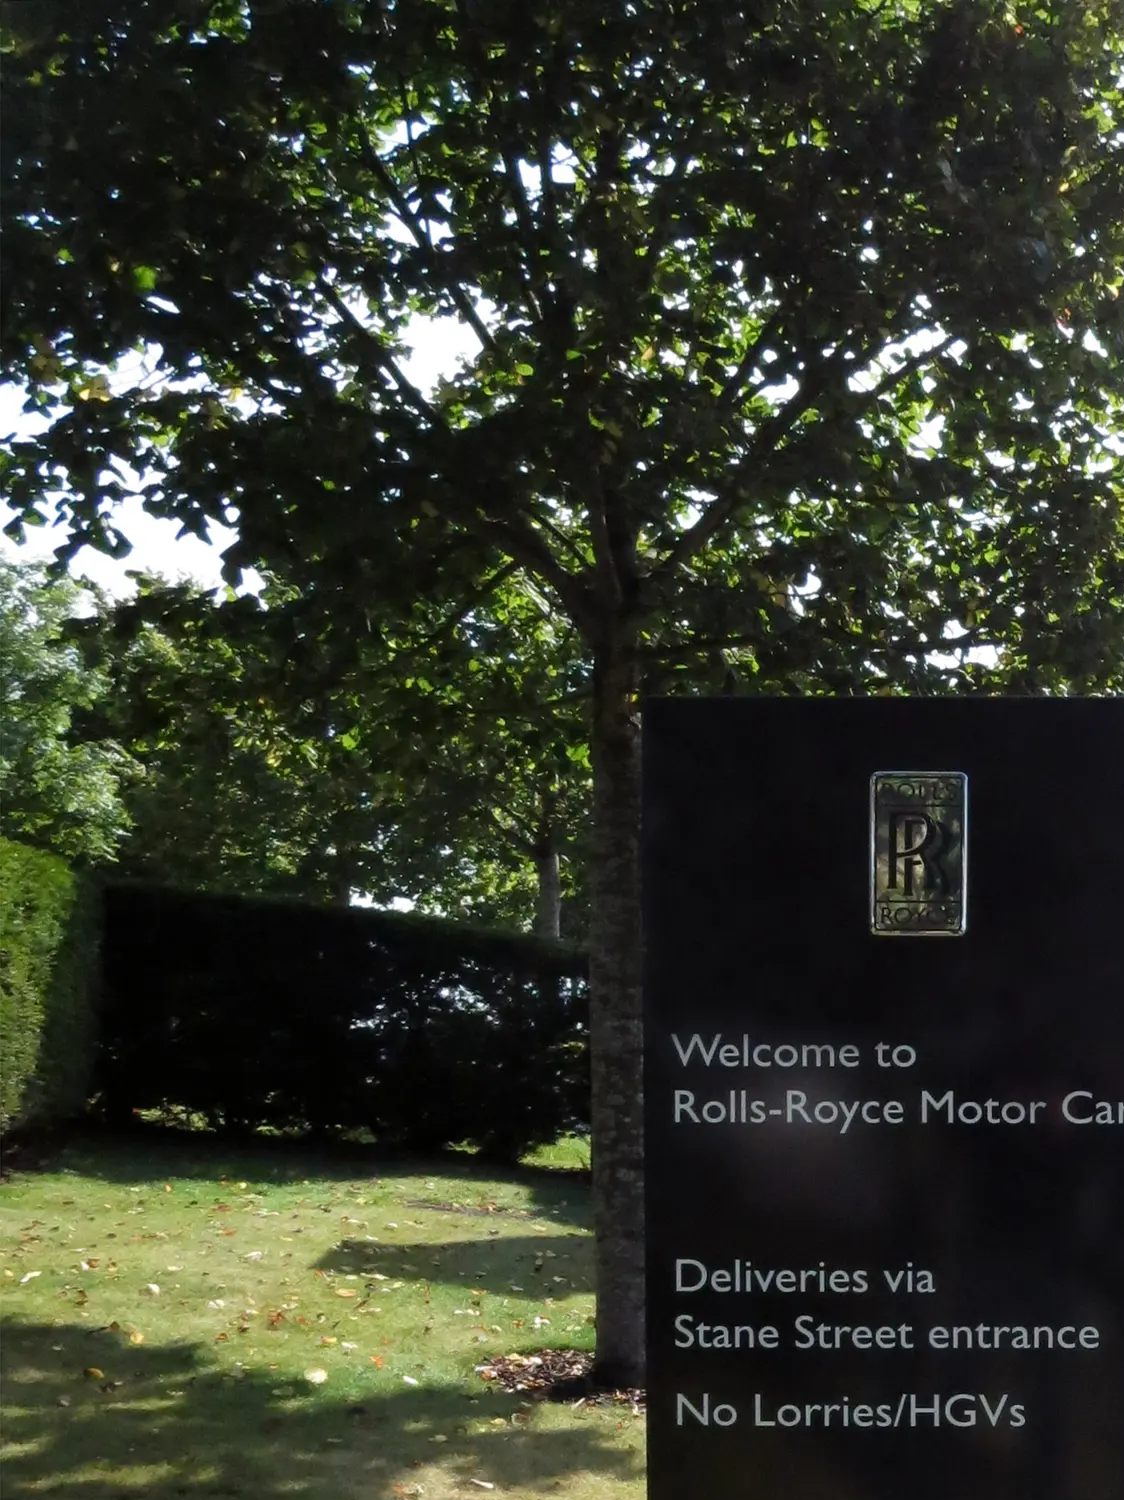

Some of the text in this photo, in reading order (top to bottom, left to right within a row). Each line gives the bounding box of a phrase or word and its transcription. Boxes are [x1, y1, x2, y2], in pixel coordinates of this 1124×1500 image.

[672, 1033, 917, 1068] Welcome to
[674, 1089, 904, 1134] Rolls-Royce
[921, 1090, 1047, 1124] Motor
[675, 1258, 936, 1293] Deliveries via
[674, 1314, 1100, 1349] Stane Street entrance
[676, 1392, 1026, 1428] No Lorries/HGVs
